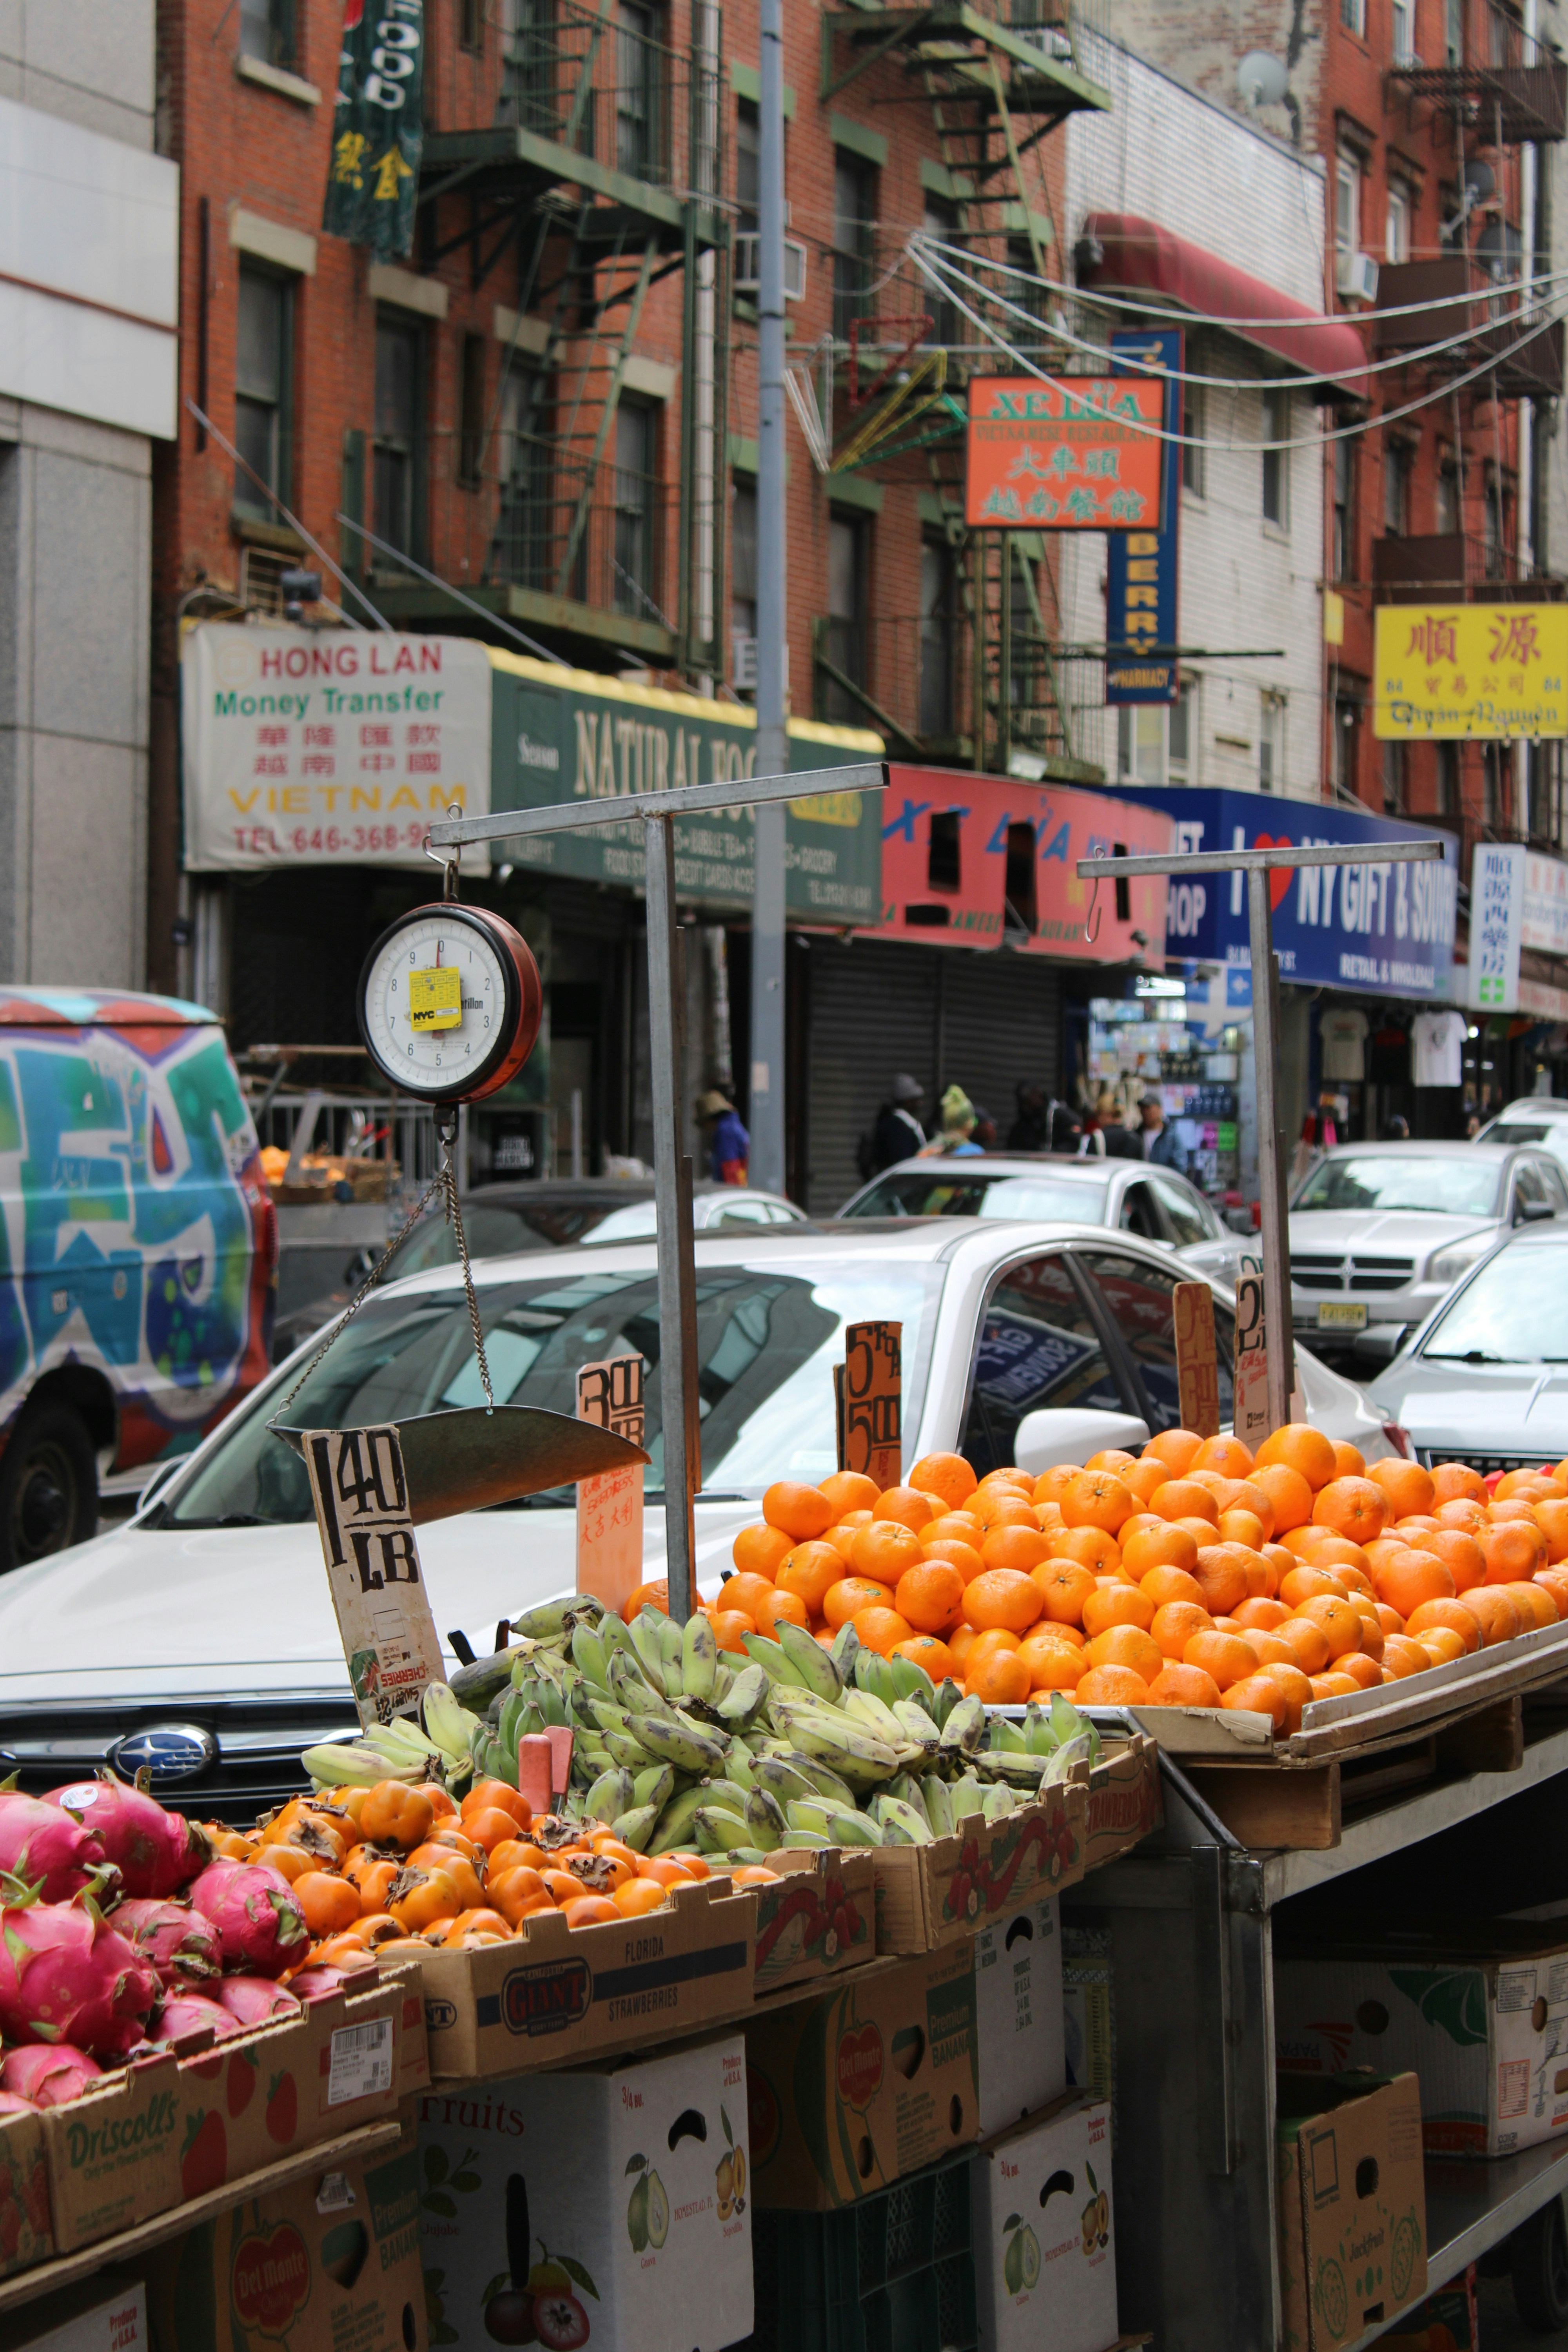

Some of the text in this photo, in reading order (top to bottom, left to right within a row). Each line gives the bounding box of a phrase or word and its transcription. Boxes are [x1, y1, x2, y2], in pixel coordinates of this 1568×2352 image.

[990, 390, 1052, 420] XE
[975, 425, 1155, 443] VIETNAMESE RESTAURANT
[1006, 445, 1120, 483] 火車頭
[979, 486, 1147, 522] 越南餐館
[1406, 613, 1542, 666] 順源
[260, 643, 442, 678] HONG LAN
[214, 684, 444, 719] Money Transfer
[227, 785, 466, 814] VIETNAM
[1340, 862, 1392, 937] GIFT
[410, 951, 416, 964] 9
[391, 979, 397, 992] 8
[485, 978, 490, 991] 2
[390, 1017, 396, 1029] 7
[414, 1011, 434, 1021] NYC
[484, 1016, 490, 1028] 3
[408, 1044, 414, 1056] 6
[436, 1054, 441, 1066] 5
[465, 1043, 471, 1055] 4
[848, 1325, 873, 1398] 5
[350, 1530, 419, 1593] LB
[380, 1666, 426, 1687] CHERRIES
[625, 1936, 664, 1963] FLORIDA
[524, 1966, 564, 1980] CALIFORNIA
[609, 1987, 678, 2022] STRAWBERRIES
[930, 2003, 969, 2037] Premium
[722, 2054, 741, 2071] Produce
[840, 2046, 880, 2080] Del Monte
[728, 2073, 742, 2087] U.S.A.
[419, 2094, 524, 2136] Fruits
[634, 2094, 644, 2108] BU.
[374, 2187, 418, 2228] Premium
[422, 2223, 460, 2238] Jujube
[723, 2222, 743, 2238] Sapodilla
[1349, 2227, 1385, 2263] Jackfruit
[238, 2250, 306, 2299] Del Monte
[110, 2305, 137, 2334] Produce
